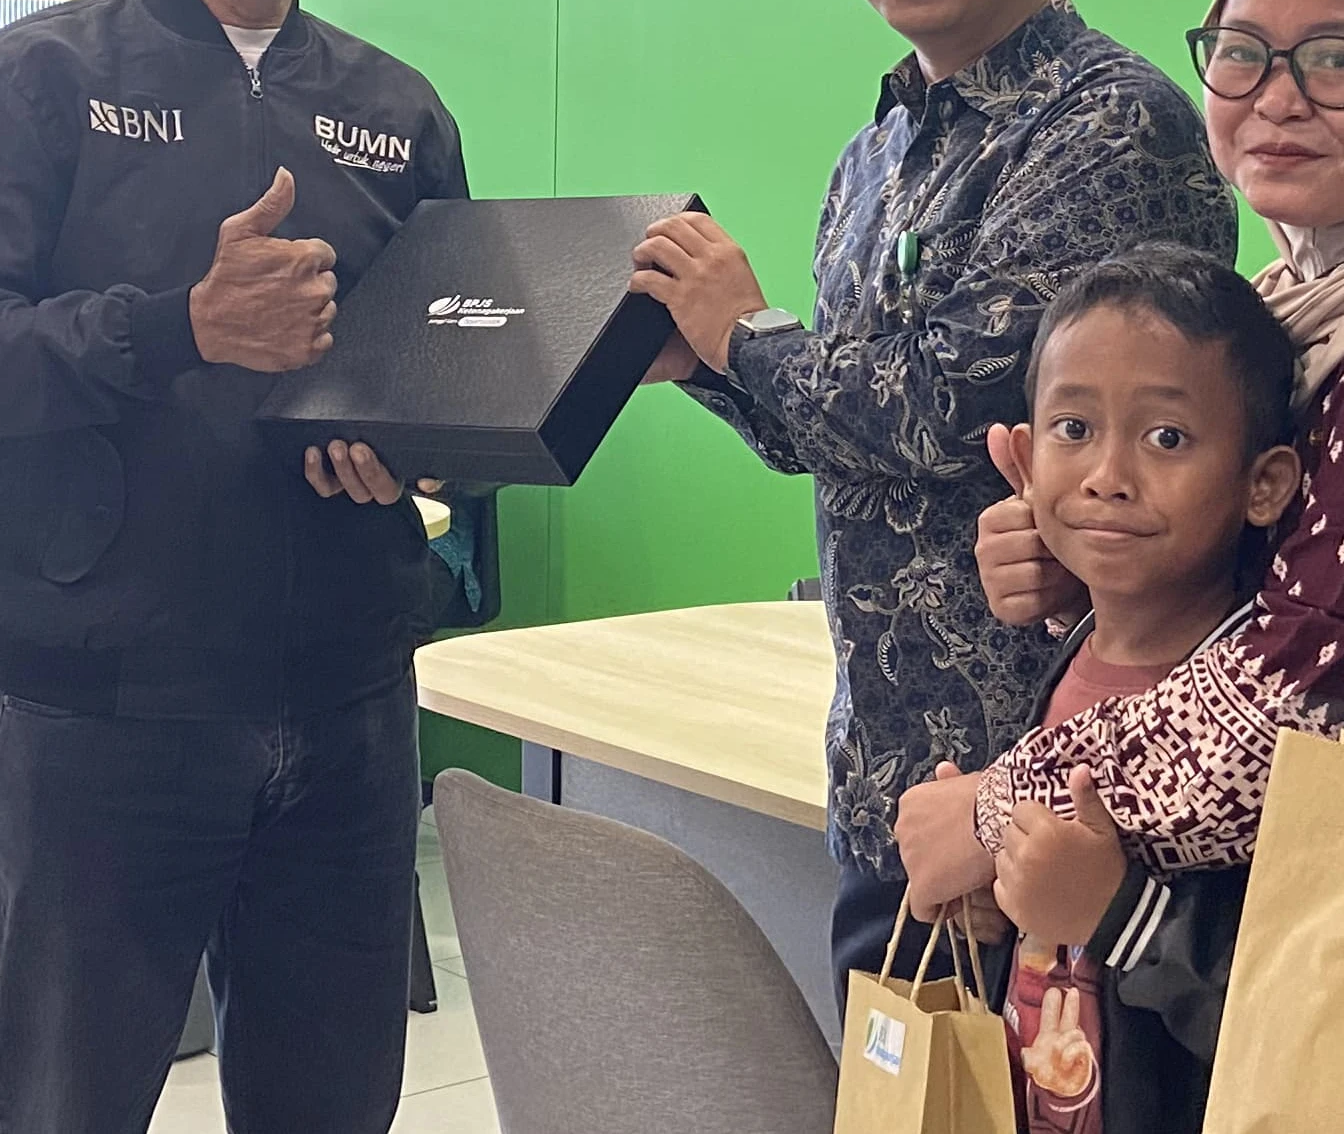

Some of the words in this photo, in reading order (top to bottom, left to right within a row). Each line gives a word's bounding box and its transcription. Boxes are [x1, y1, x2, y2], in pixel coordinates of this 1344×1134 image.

[120, 106, 184, 143] BNI
[315, 115, 411, 161] BUMN
[462, 298, 494, 308] BPJS
